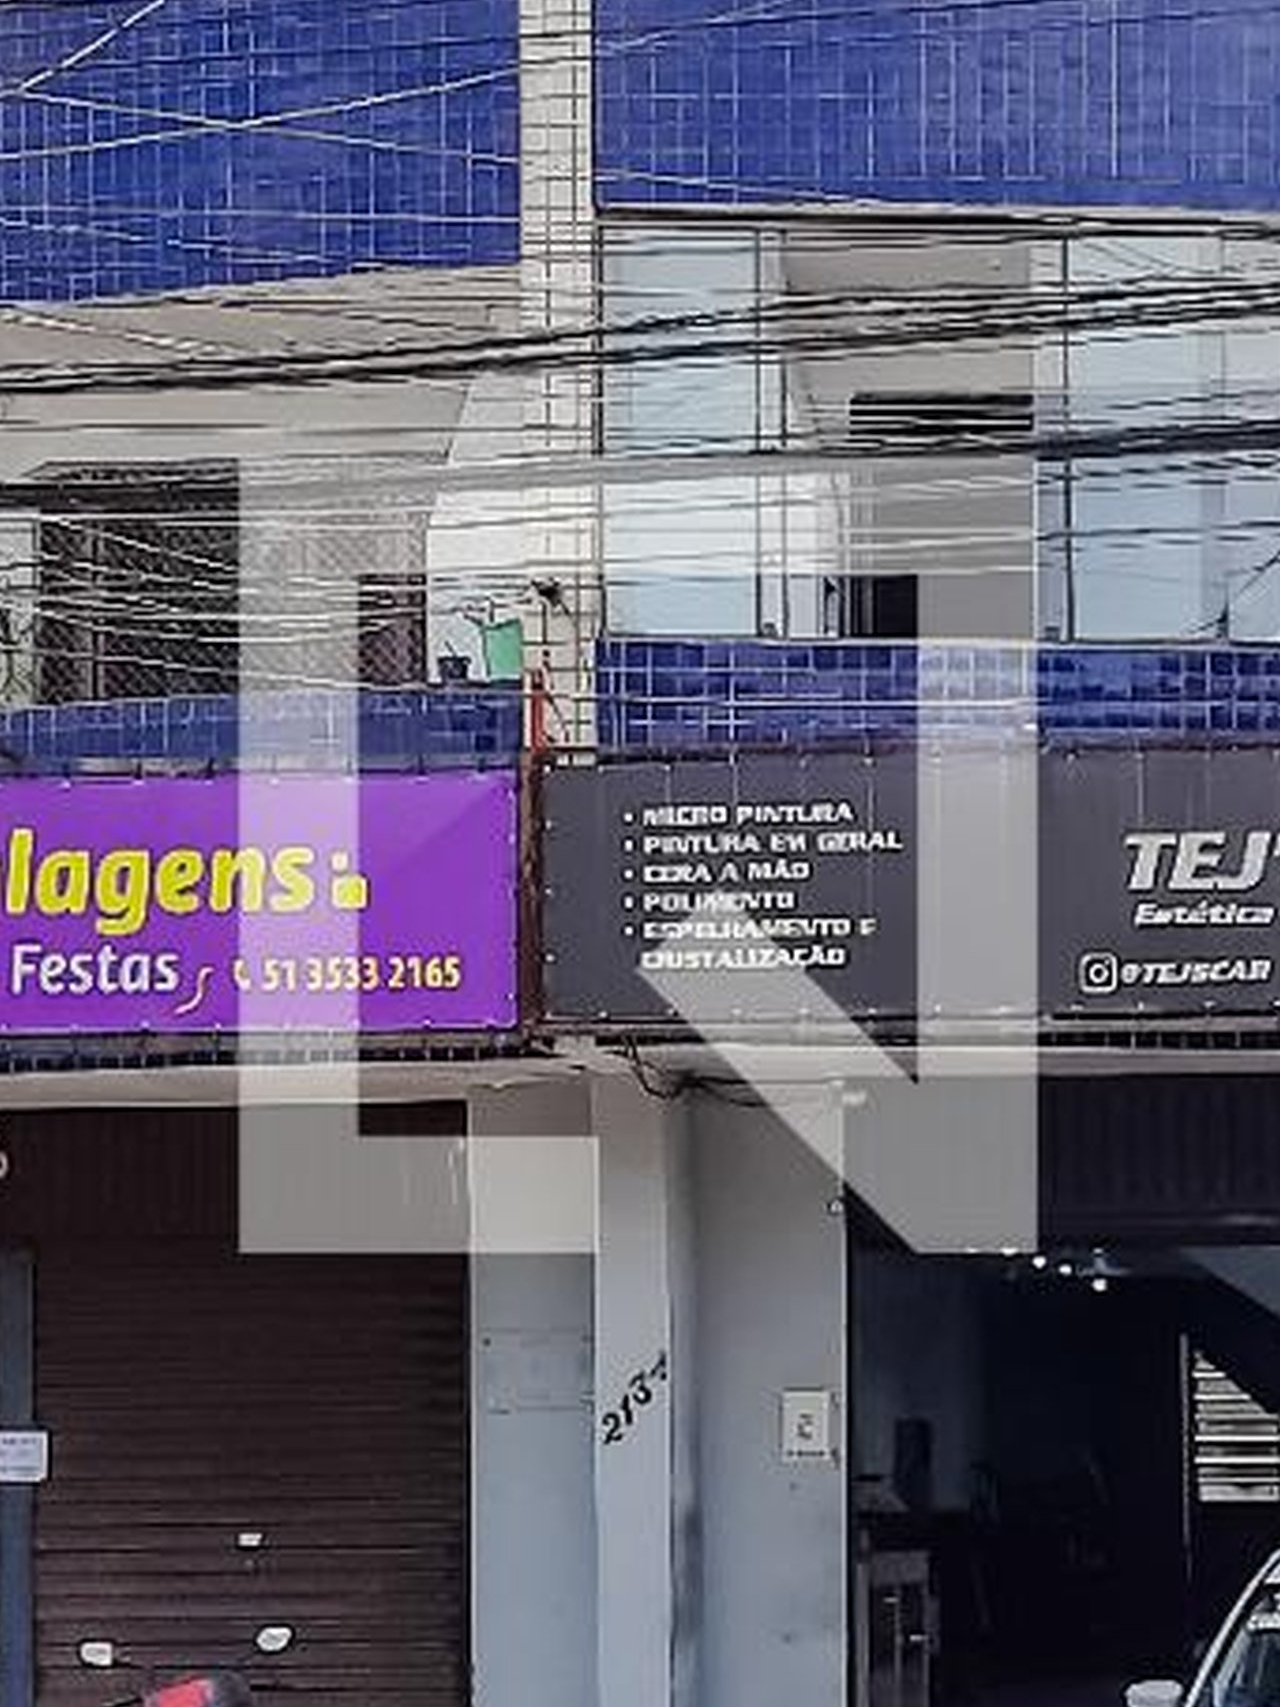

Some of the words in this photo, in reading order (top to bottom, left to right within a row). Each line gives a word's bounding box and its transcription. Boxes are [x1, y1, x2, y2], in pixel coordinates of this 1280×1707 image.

[642, 805, 728, 826] MICRO
[736, 802, 855, 825] PINTURA
[642, 833, 761, 854] PINTURA
[770, 833, 807, 853] EM
[817, 830, 904, 852] GERAL
[642, 863, 713, 883] CERA
[718, 862, 740, 882] A
[642, 891, 796, 912] POLIMENTO
[11, 943, 180, 994] Festas
[263, 958, 296, 990] 51
[301, 955, 381, 991] 3533
[387, 954, 462, 990] 2165
